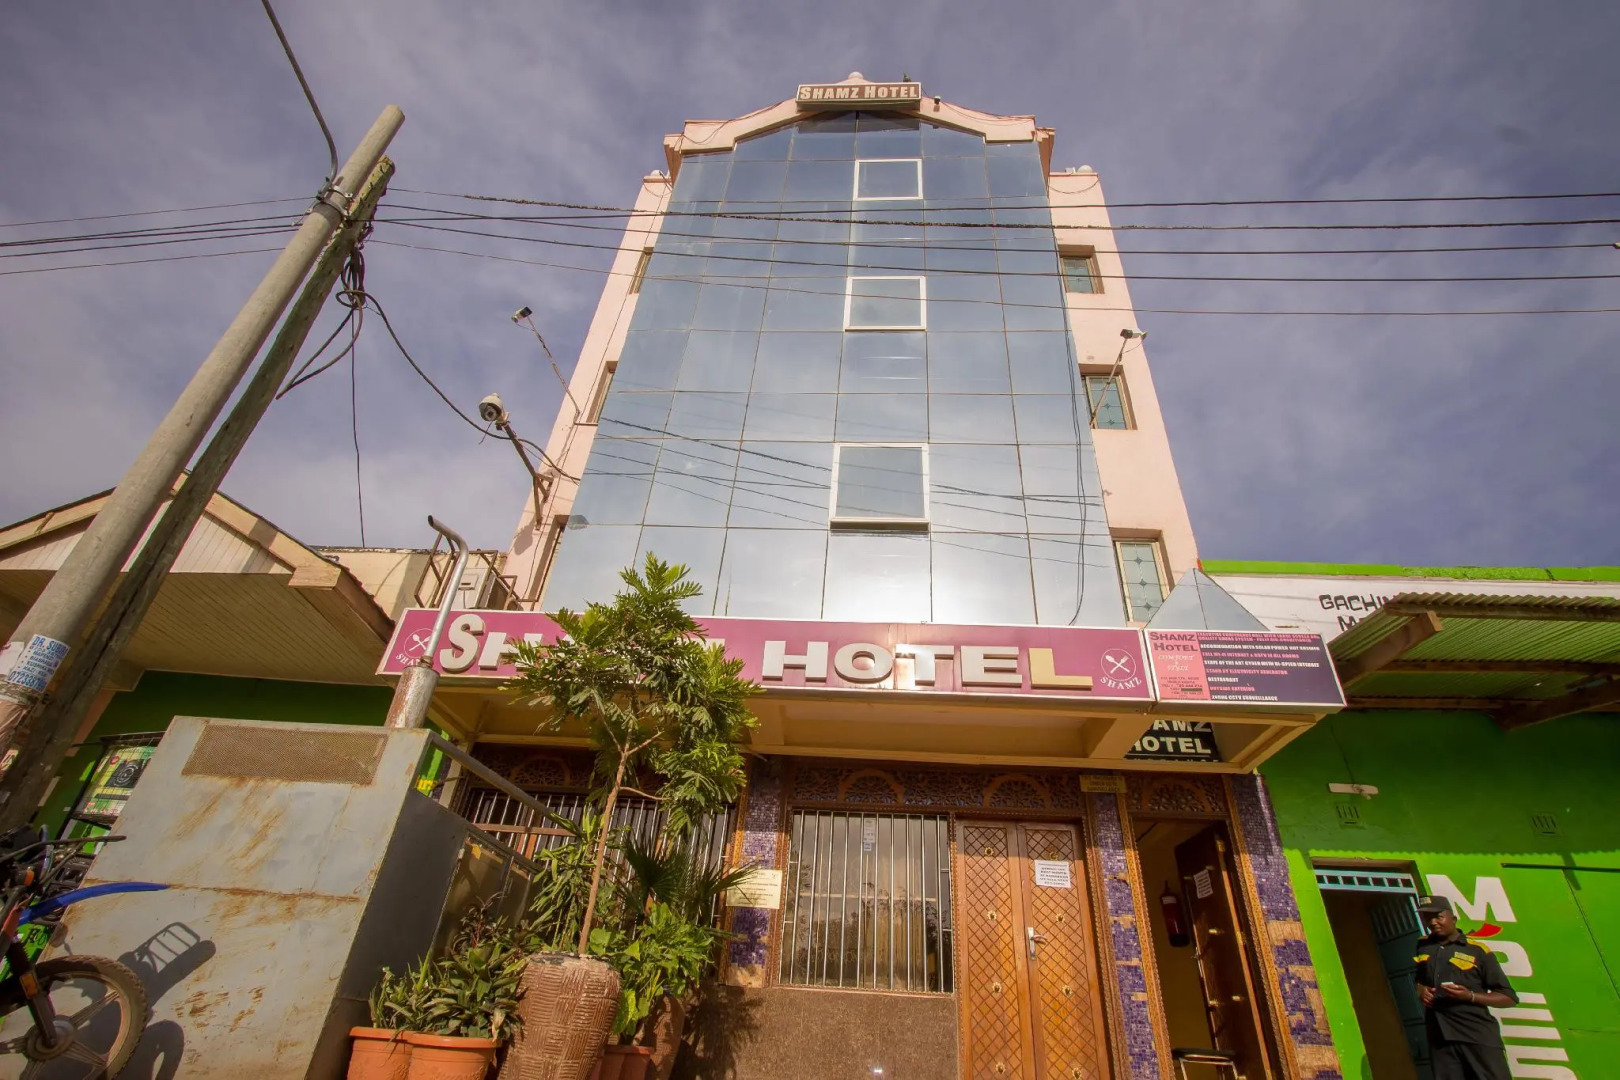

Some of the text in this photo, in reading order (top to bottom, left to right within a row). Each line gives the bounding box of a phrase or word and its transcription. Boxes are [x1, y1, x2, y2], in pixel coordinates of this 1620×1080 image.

[800, 85, 918, 100] SHAMZ HOTEL
[1149, 631, 1197, 642] SHAMZ
[1153, 642, 1198, 652] HOTEL
[761, 640, 1093, 691] HOTEL
[1100, 676, 1142, 690] SHAMZ
